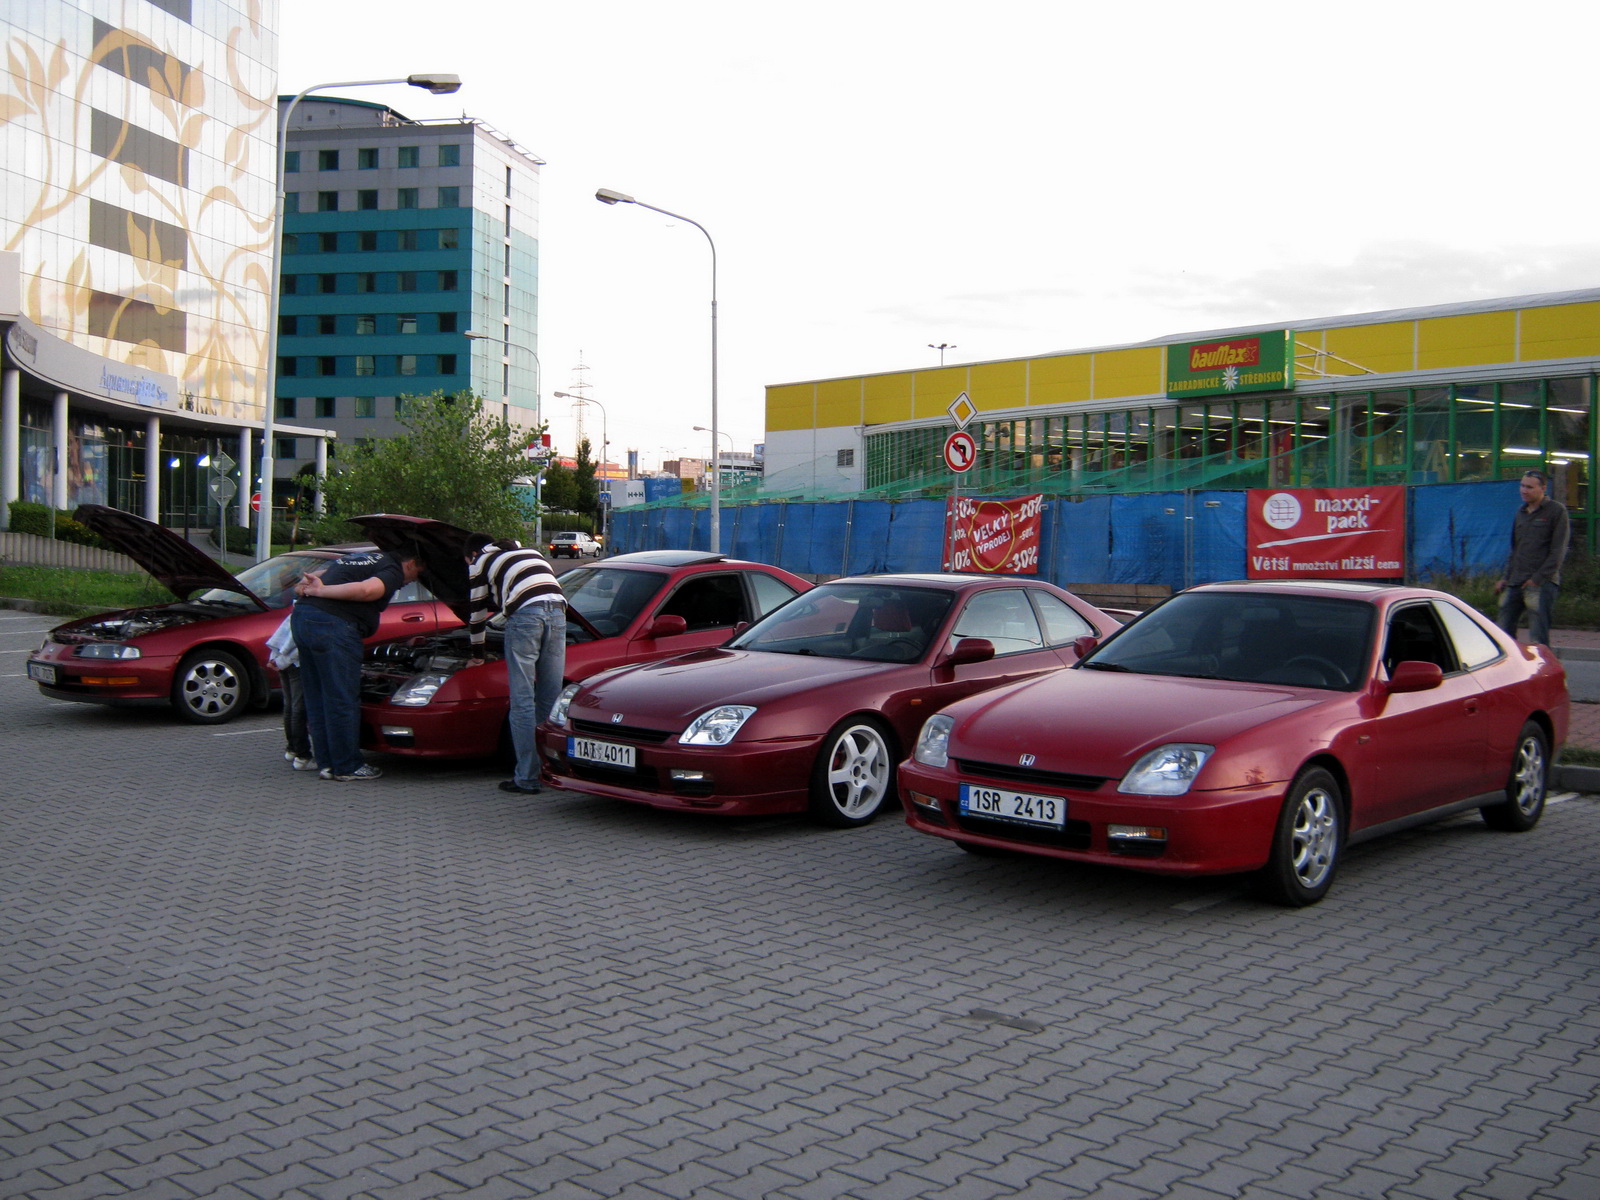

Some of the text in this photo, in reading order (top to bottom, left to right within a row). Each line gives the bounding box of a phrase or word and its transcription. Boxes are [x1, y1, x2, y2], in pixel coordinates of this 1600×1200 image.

[1168, 371, 1283, 392] ZAHRADNICKÉ STŘEDISKO
[947, 498, 976, 520] -0%
[1013, 494, 1044, 522] -20%
[1315, 494, 1380, 512] maxxi-
[973, 510, 1008, 542] VELKÝ
[1327, 511, 1368, 533] pack
[944, 548, 971, 571] -0%
[1006, 546, 1038, 572] -30%
[1253, 555, 1400, 571] Větší množství nižší cena
[604, 745, 630, 764] 4011
[973, 789, 1056, 820] 1SR 2413
